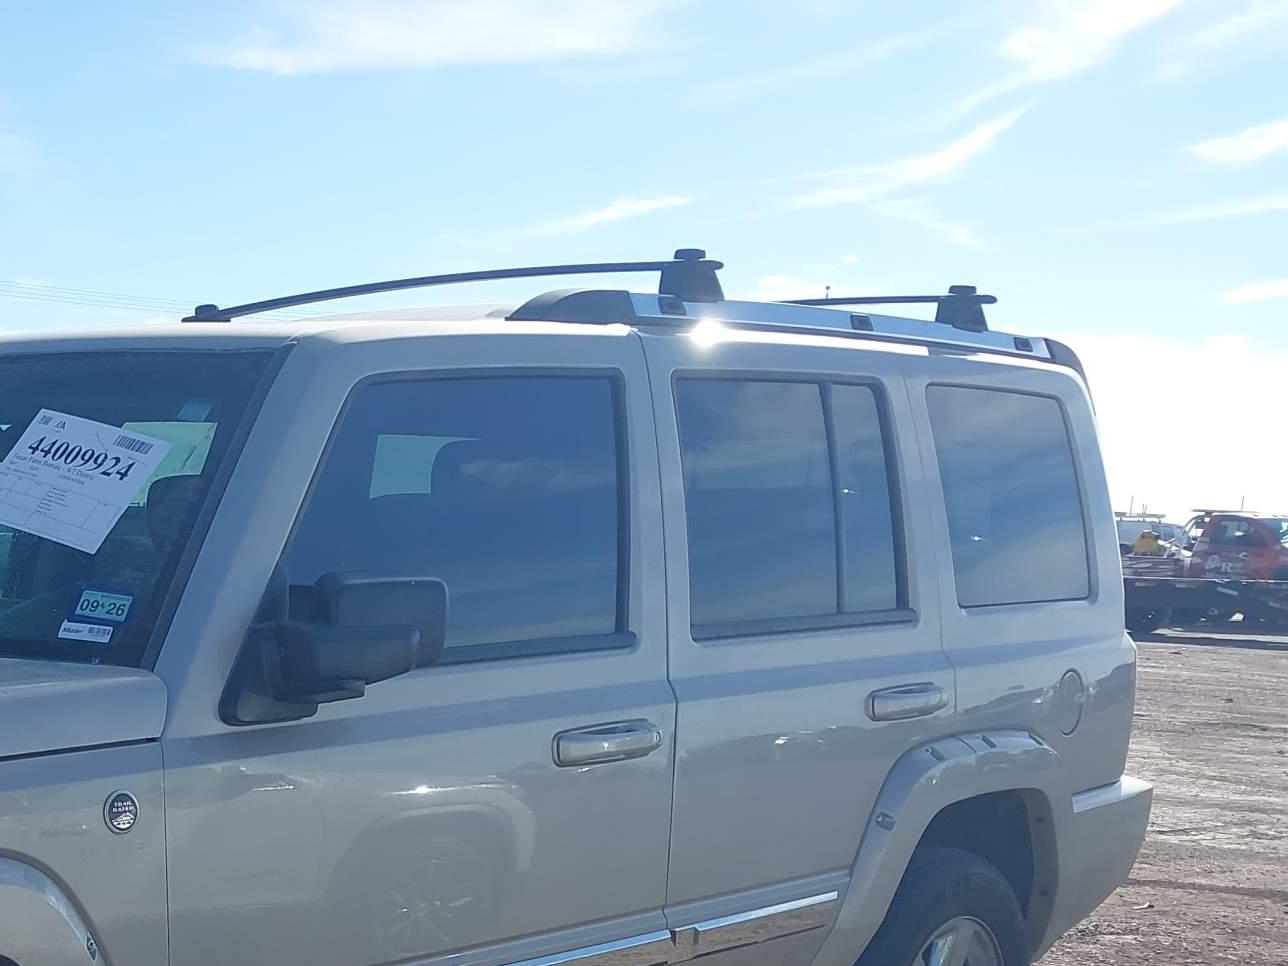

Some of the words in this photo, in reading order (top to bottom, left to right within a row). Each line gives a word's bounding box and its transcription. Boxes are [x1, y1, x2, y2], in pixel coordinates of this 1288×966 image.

[28, 435, 137, 481] 44009924
[79, 598, 100, 613] 09
[105, 602, 127, 617] 26
